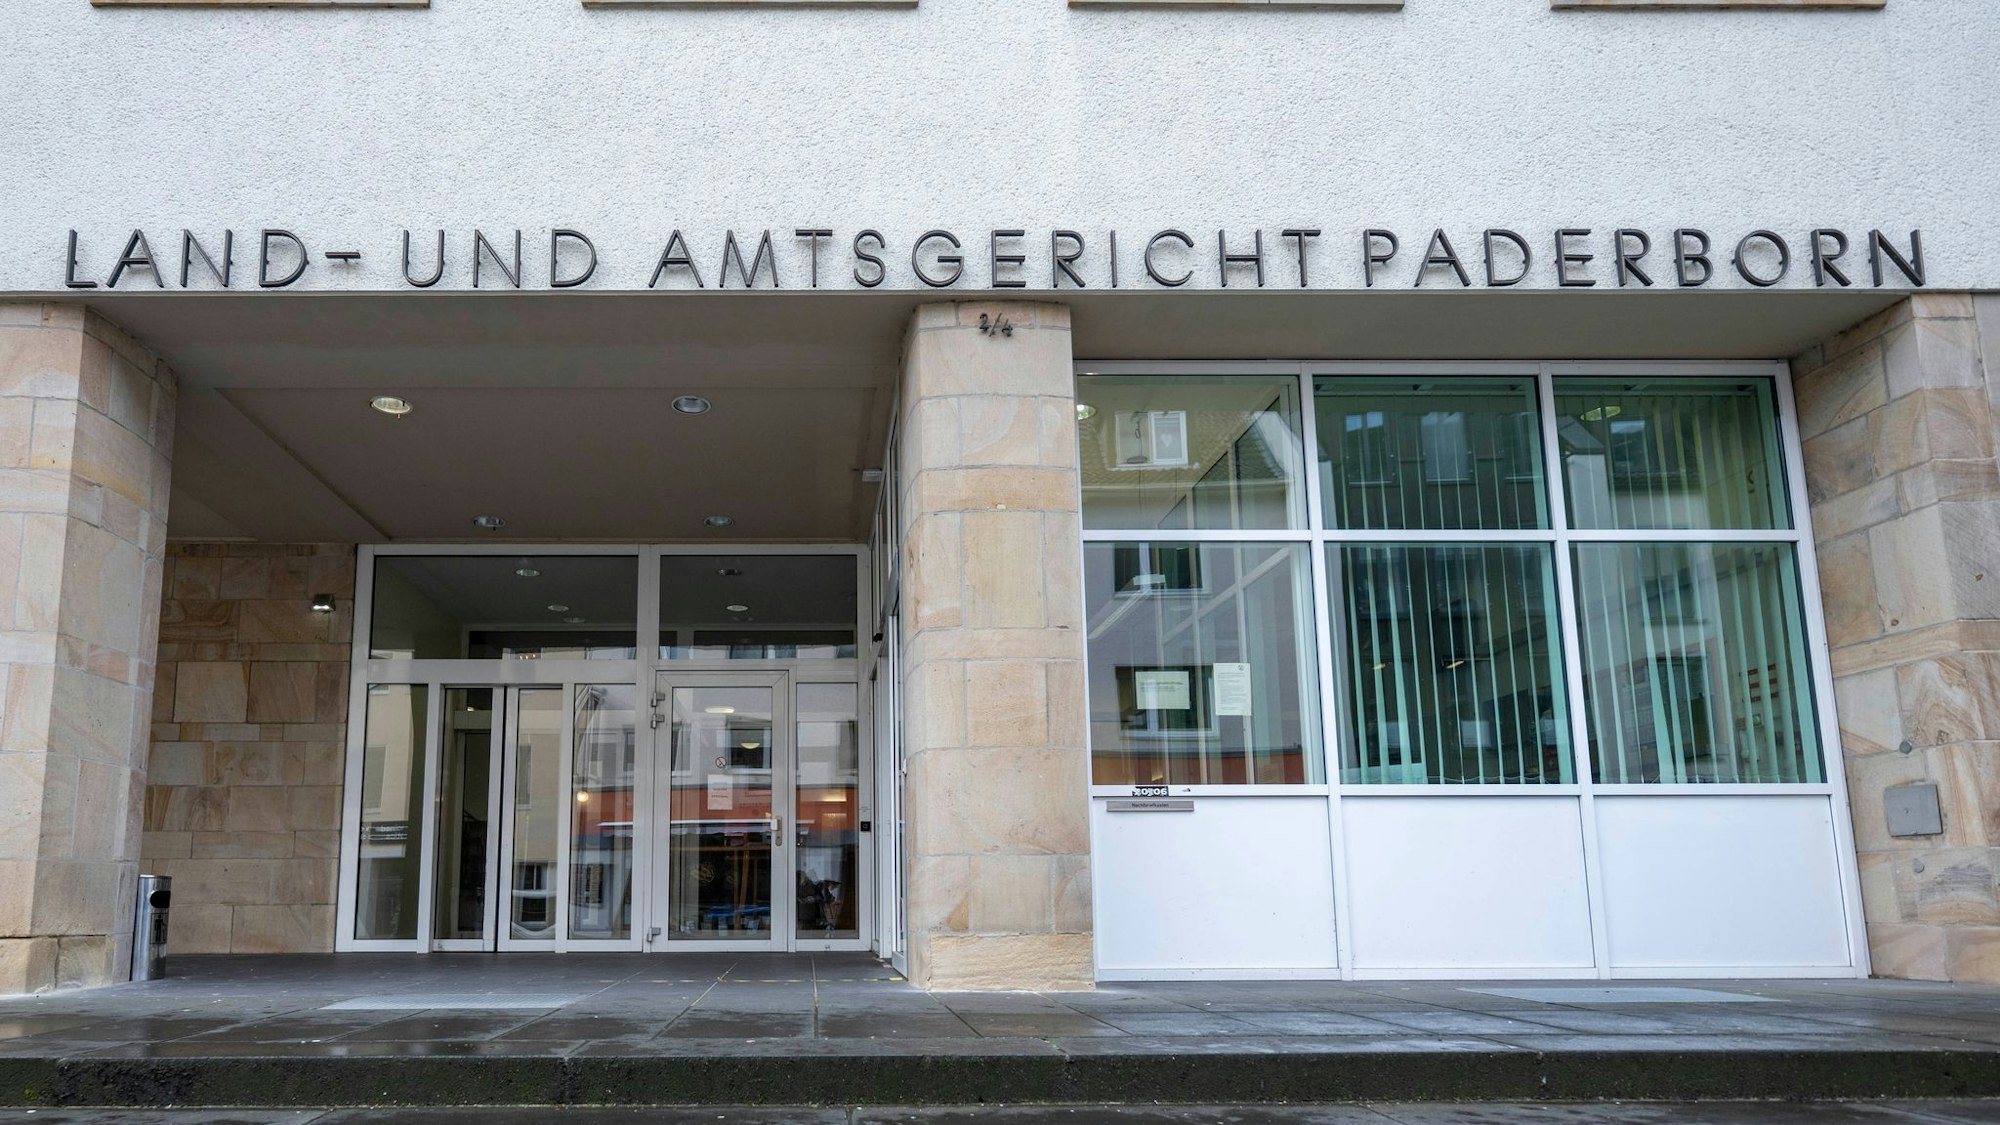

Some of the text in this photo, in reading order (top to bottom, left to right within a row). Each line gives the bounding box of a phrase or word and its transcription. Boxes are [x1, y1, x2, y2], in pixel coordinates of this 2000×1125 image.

[65, 228, 1926, 288] LAND- UND AMTSGERICHT PADERBORN
[979, 313, 1014, 337] 2/4
